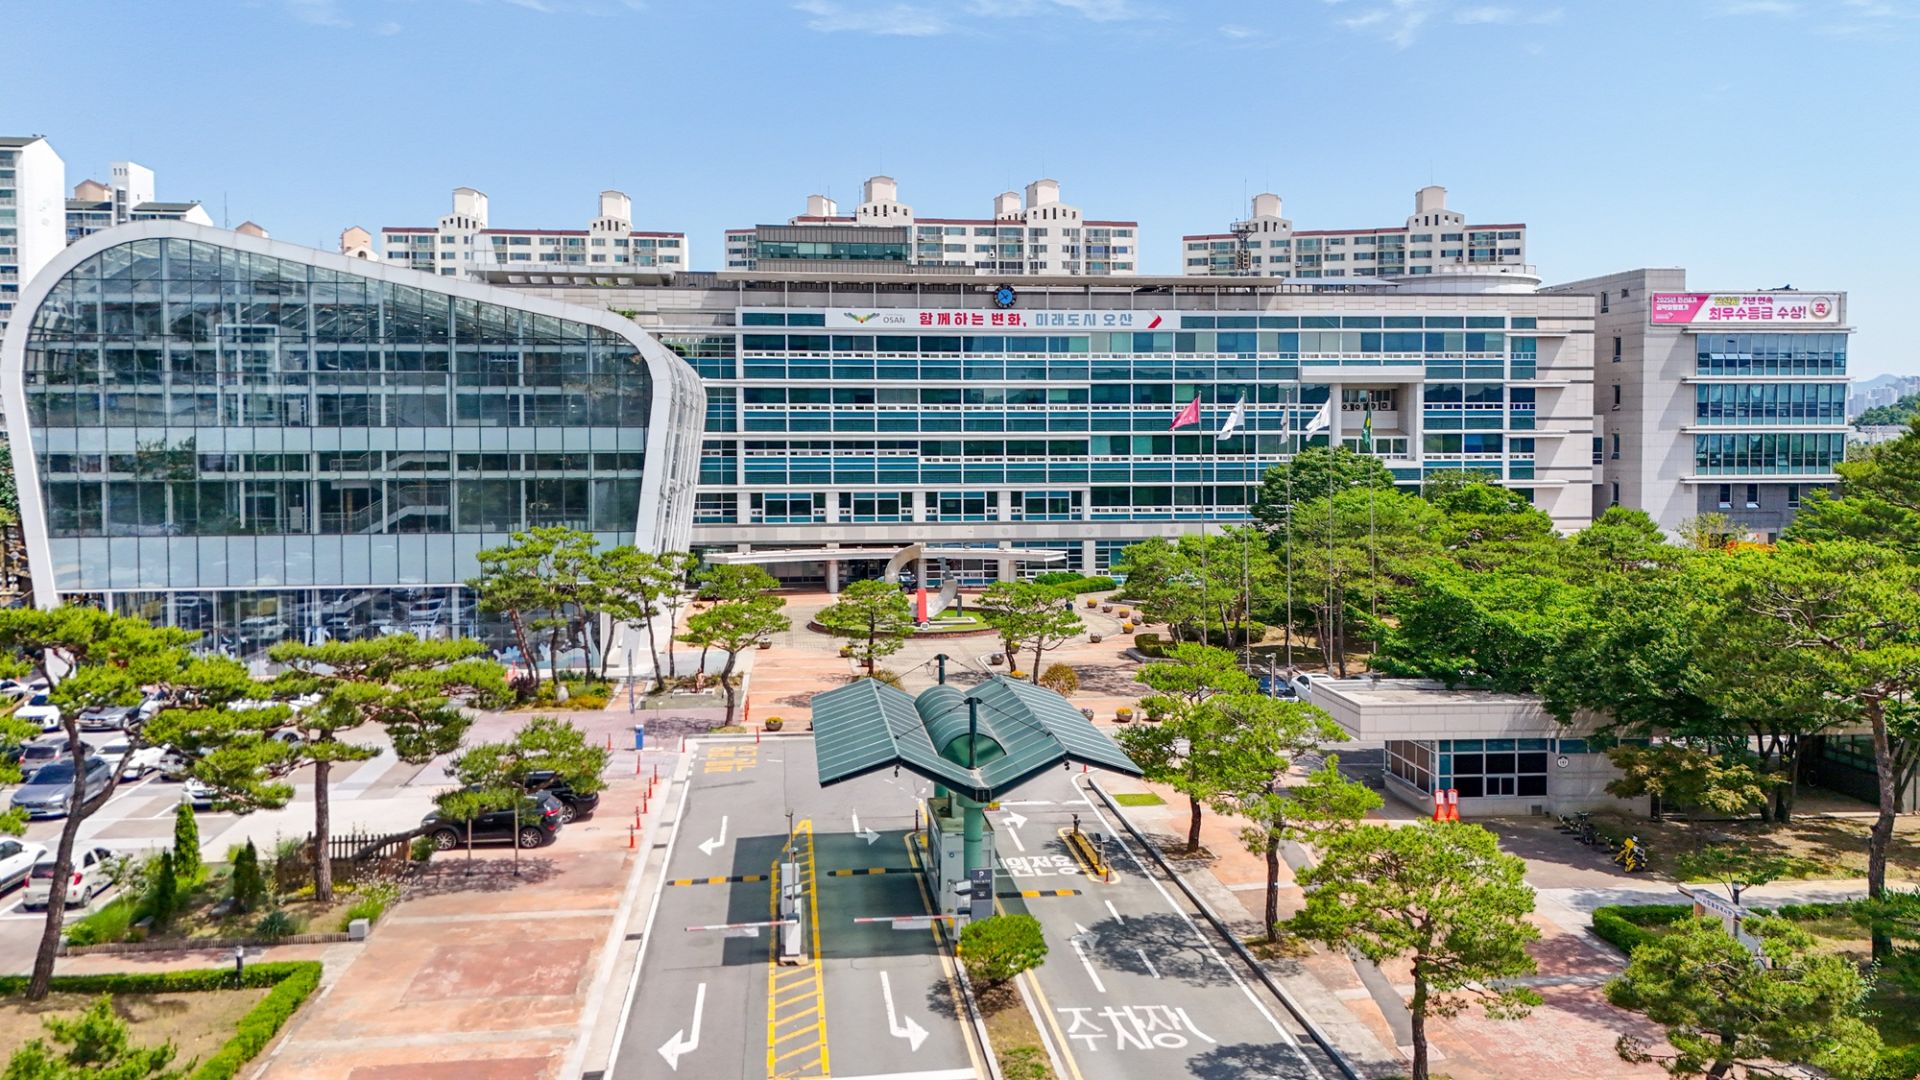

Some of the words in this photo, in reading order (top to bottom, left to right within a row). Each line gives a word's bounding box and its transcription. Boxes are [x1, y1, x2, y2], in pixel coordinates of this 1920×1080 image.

[1742, 296, 1756, 305] 2년
[883, 316, 905, 324] OSAN
[919, 312, 984, 326] 함께하는
[991, 312, 1028, 327] 변화,
[1035, 313, 1097, 326] 미래도시
[1103, 313, 1133, 326] 오산
[1709, 306, 1773, 320] 최우수등급
[1777, 306, 1806, 319] 수상!
[1057, 1005, 1188, 1051] 주차장
